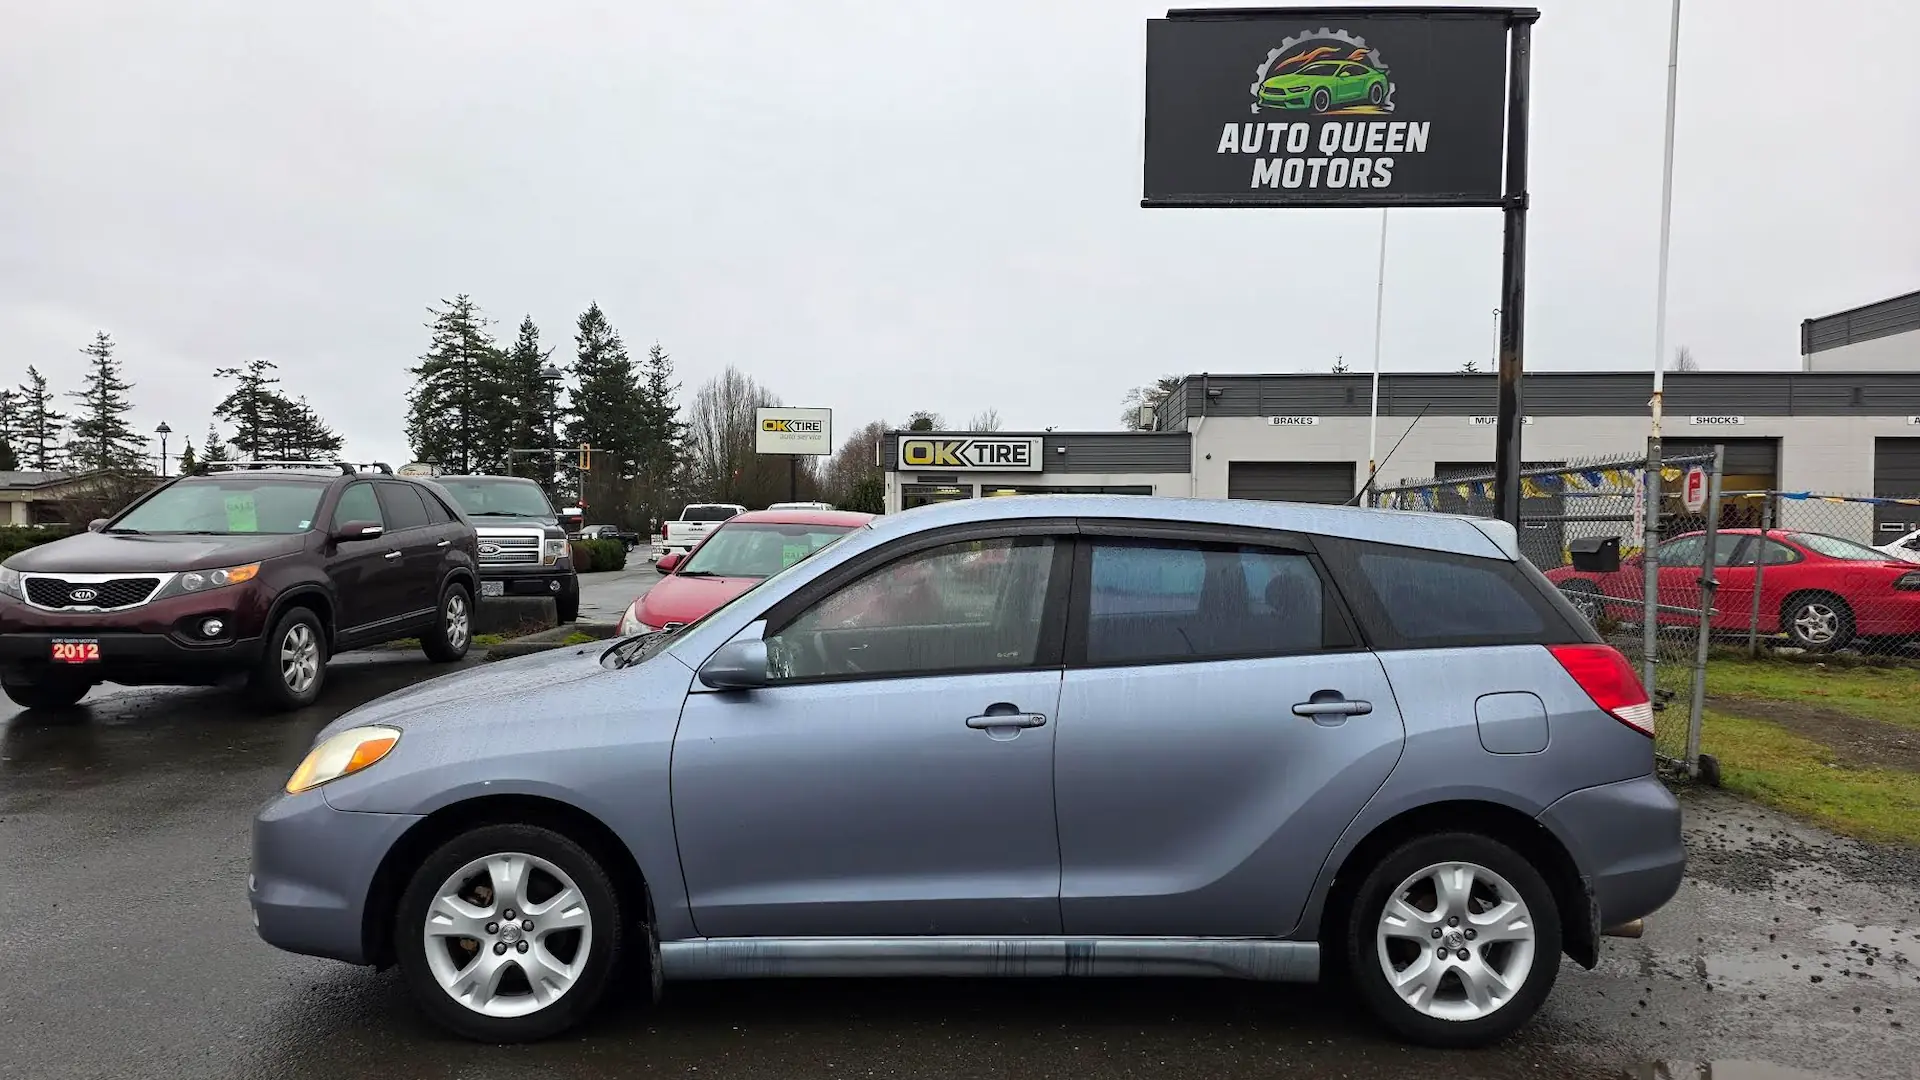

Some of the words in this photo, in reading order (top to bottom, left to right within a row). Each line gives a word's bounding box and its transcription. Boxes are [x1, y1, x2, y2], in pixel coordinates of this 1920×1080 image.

[1217, 122, 1310, 154] AUTO
[1318, 121, 1431, 156] QUEEN
[1251, 157, 1394, 189] MOTORS
[762, 419, 791, 432] OK
[794, 421, 820, 431] TIRE
[1273, 417, 1313, 425] BRAKES
[1475, 417, 1527, 425] MUFS
[1696, 416, 1739, 424] SHOCKS
[904, 440, 966, 466] OK
[974, 444, 1027, 463] TIRE
[74, 591, 92, 599] KIA
[53, 643, 99, 659] 2012
